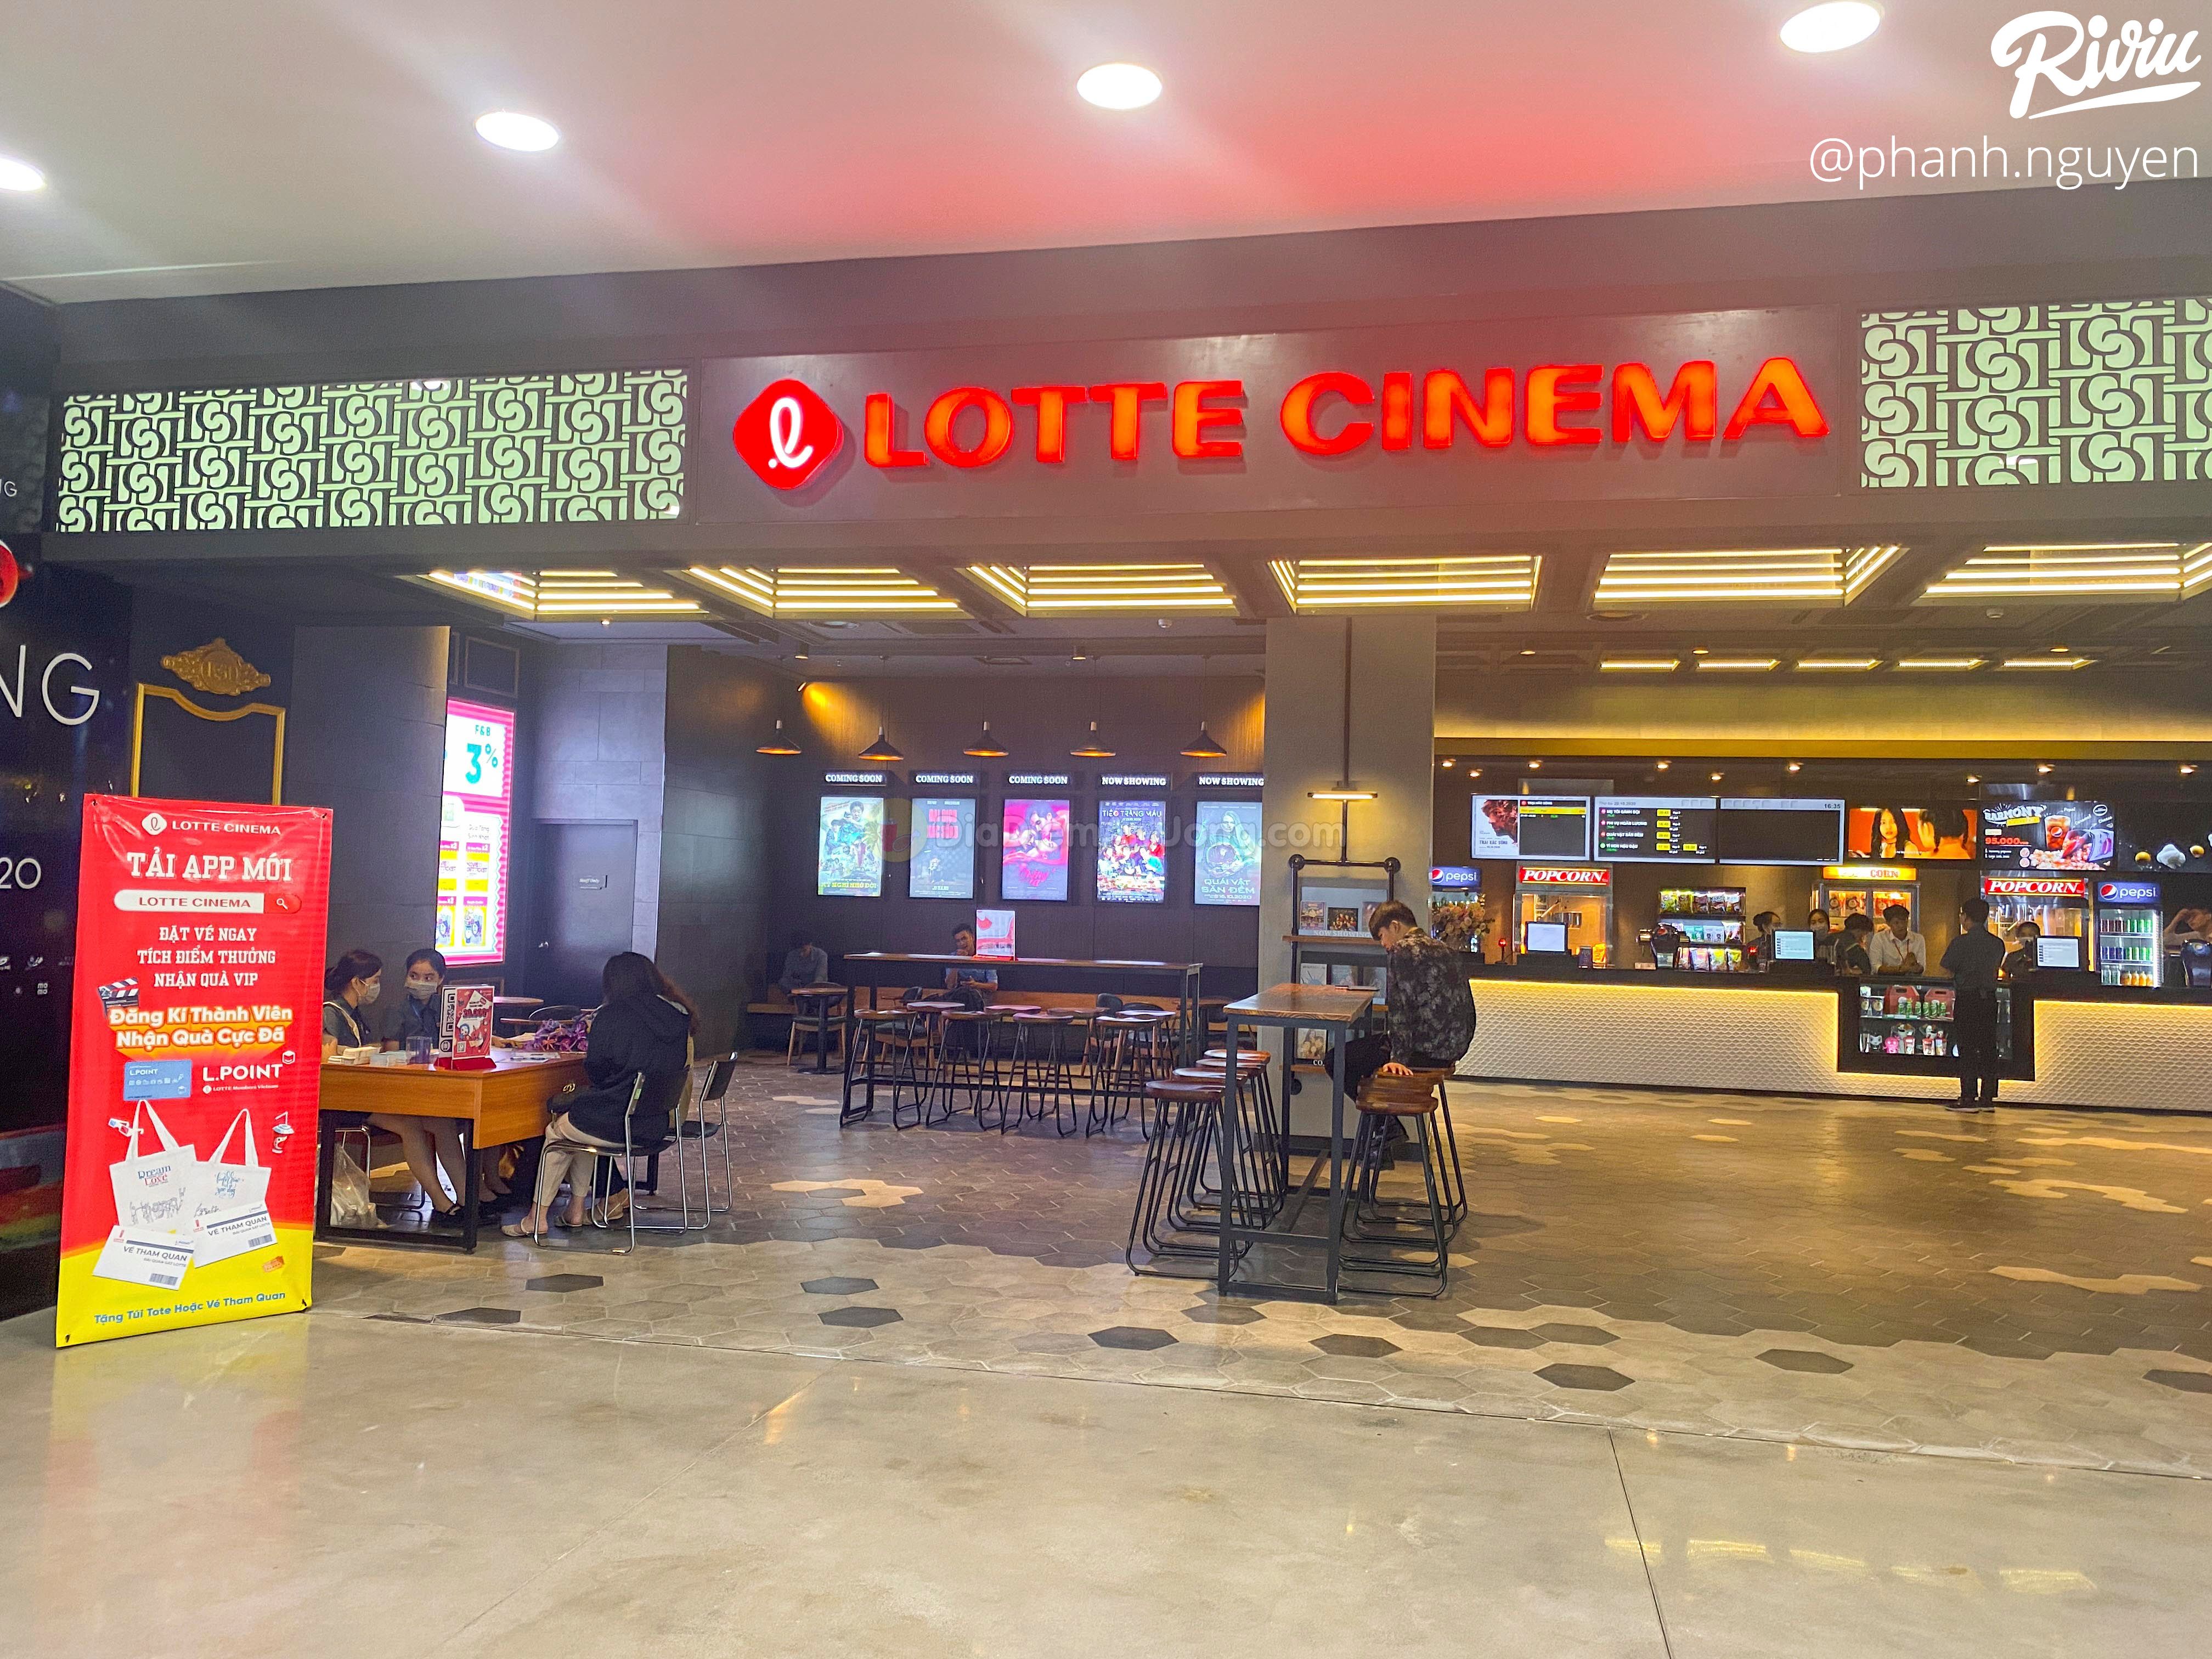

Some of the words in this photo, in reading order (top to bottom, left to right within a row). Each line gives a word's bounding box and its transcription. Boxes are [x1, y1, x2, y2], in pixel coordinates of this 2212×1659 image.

[864, 380, 1243, 468] LOTTE
[1280, 357, 1830, 455] CINEMA
[916, 775, 949, 783] COMING
[1009, 776, 1043, 784] COMING
[1043, 776, 1068, 785] SOON
[1124, 777, 1166, 786] SHOWING
[1199, 777, 1221, 785] NOW
[1221, 777, 1264, 786] SHOWING
[172, 821, 219, 832] LOTTE
[224, 823, 281, 835] CINEMA
[127, 846, 176, 878] TẢI
[182, 855, 235, 881] APP
[242, 853, 294, 882] MỚI
[1446, 872, 1476, 882] pepsi
[1523, 870, 1605, 882] POPCORN
[1870, 870, 1899, 878] CORN
[1989, 881, 2079, 894] POPCORN
[2119, 887, 2156, 899] pepsi
[139, 897, 187, 906] LOTTE
[193, 898, 251, 907] CINEMA
[159, 927, 189, 944] ĐẶT
[194, 925, 215, 941] VÉ
[218, 928, 257, 941] NGAY
[137, 947, 172, 964] TÍCH
[176, 945, 214, 964] ĐIỂM
[217, 947, 276, 964] THƯỞNG
[154, 970, 197, 989] NHẬN
[200, 970, 229, 988] QUÀ
[233, 973, 258, 986] VIP
[110, 1008, 163, 1028] Đăng
[190, 1007, 249, 1022] Thành
[252, 1006, 293, 1021] Viên
[117, 1030, 168, 1051] Nhận
[172, 1028, 214, 1045] Quà
[217, 1029, 255, 1047] Cực
[258, 1026, 285, 1041] Đã
[202, 1063, 283, 1082] L.POINT
[221, 1222, 243, 1233] THAM
[245, 1216, 267, 1226] QUAN
[136, 1248, 160, 1257] THAM
[161, 1252, 187, 1261] QUAN
[94, 1313, 123, 1325] Tặng
[127, 1310, 143, 1319] Túi
[147, 1307, 171, 1317] Tote
[174, 1302, 203, 1314] Hoặc
[206, 1299, 220, 1309] Vé
[223, 1296, 253, 1307] Tham
[256, 1292, 285, 1302] Quan
